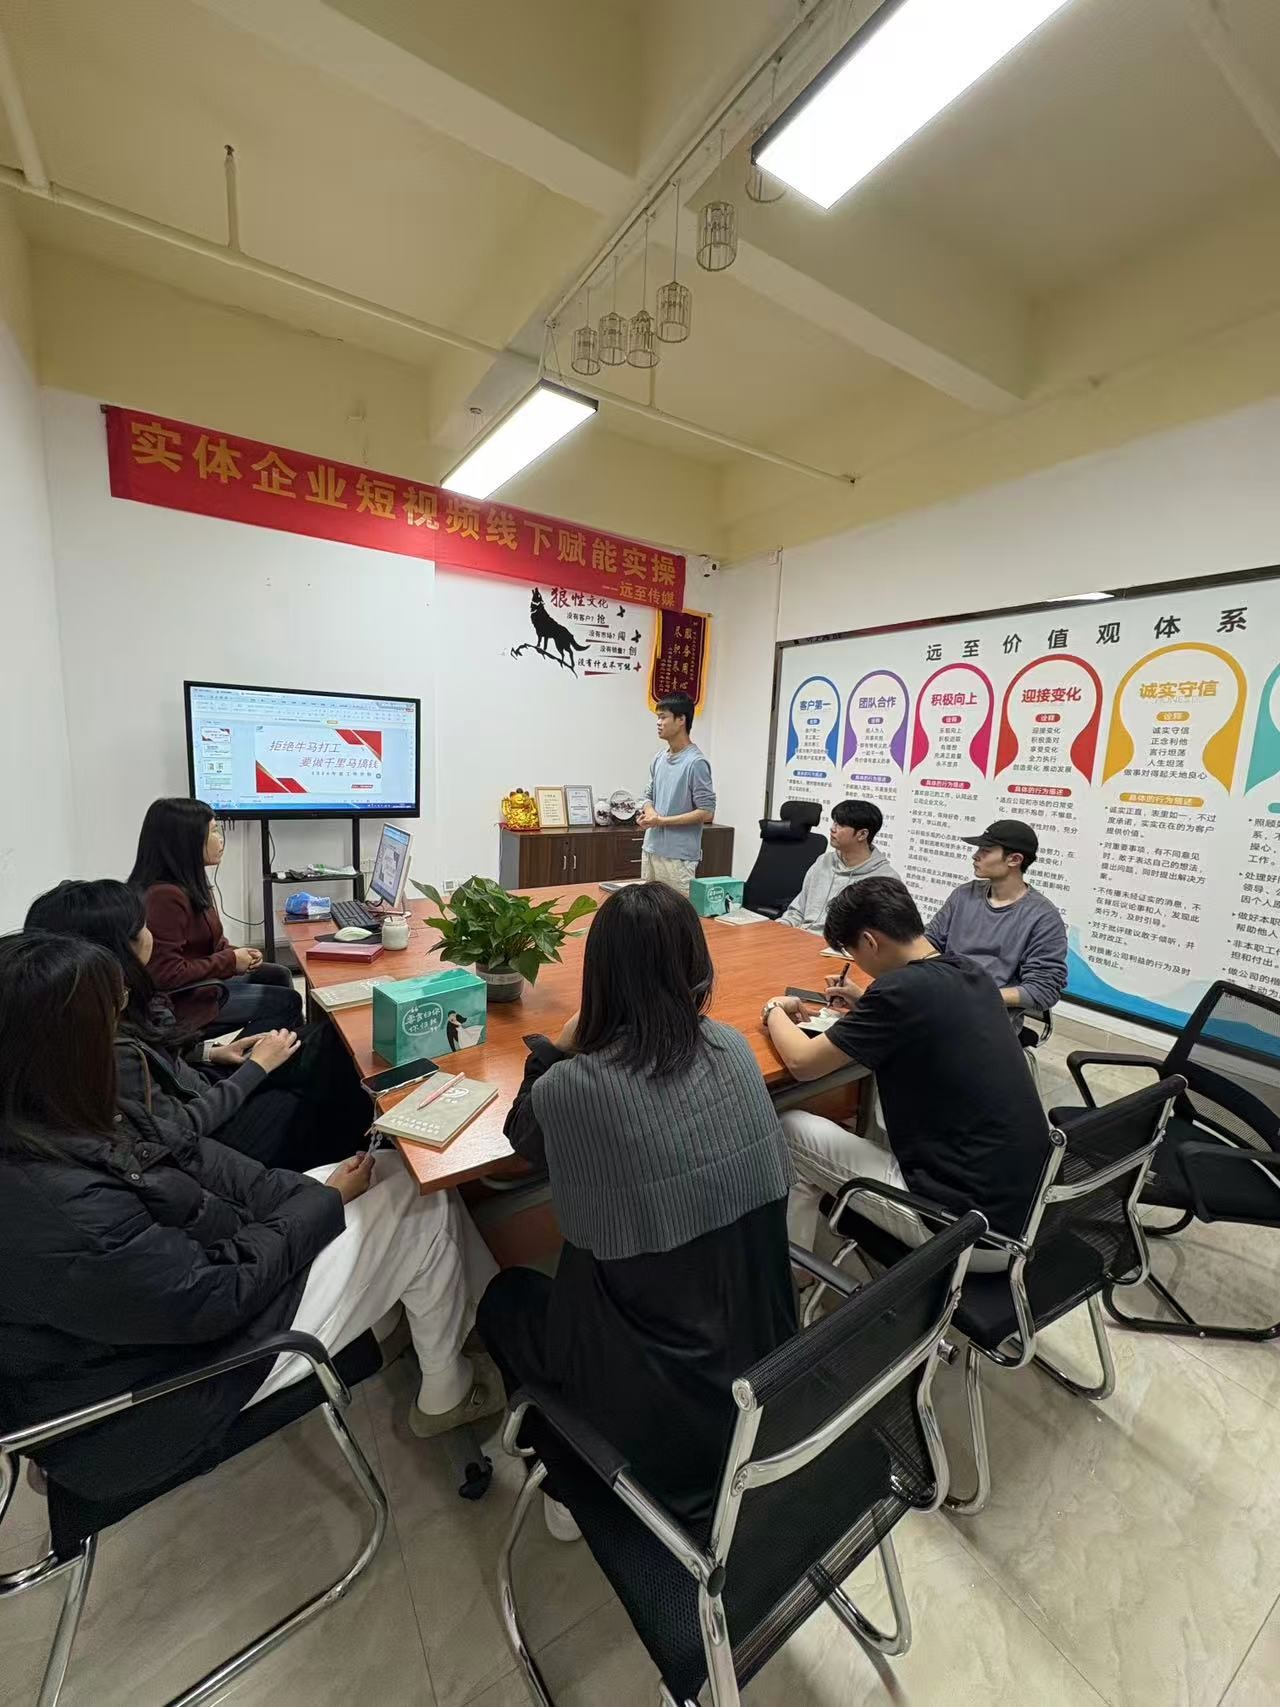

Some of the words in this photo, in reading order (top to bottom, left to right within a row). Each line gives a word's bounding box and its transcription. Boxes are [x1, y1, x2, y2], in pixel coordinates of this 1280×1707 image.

[131, 422, 676, 586] 实体企业短视频线下赋能实操
[551, 587, 608, 608] 狼性文化
[597, 614, 605, 624] 抢
[618, 631, 626, 641] 闯
[926, 607, 1248, 661] 远至价值观体系
[629, 646, 637, 656] 创
[578, 658, 631, 670] 没有什么不可能
[1021, 687, 1082, 703] 迎接变化
[1139, 680, 1219, 699] 诚实守信
[800, 700, 831, 710] 客户第一
[859, 696, 896, 709] 团队合作
[931, 692, 978, 706] 积极向上
[1152, 726, 1190, 735] 诚实守信
[269, 741, 341, 753] 拒绝牛马打工
[1150, 737, 1188, 746] 正念利他
[1149, 748, 1186, 756] 言行坦荡
[299, 757, 379, 769] 要做千里马搞钱
[1147, 759, 1184, 767] 人生坦荡
[1124, 769, 1208, 780] 做事对得起天地良心
[1014, 786, 1064, 796] 具体的行为描述
[1129, 794, 1193, 806] 具体的行为描述
[1110, 807, 1216, 822] 诚实正直，表里如一，不过
[1107, 817, 1215, 833] 度承诺，实实在在的为客户
[1106, 827, 1145, 838] 提供价值。
[1103, 842, 1200, 861] 对重要事项，有不同意见
[1102, 852, 1203, 873] 时，敢于表达自己的想法，
[1248, 855, 1275, 866] 工作。
[1101, 862, 1206, 885] 提出问题，同时提出解决方
[1244, 871, 1280, 884] 处理好
[1098, 887, 1201, 912] 不传播未经证实的消息，不
[1096, 897, 1200, 923] 在背后议论事和人，发现此
[1091, 931, 1127, 946] 及时改正。
[1093, 921, 1195, 950] 对于批评建议敢于倾听，并
[1088, 955, 1123, 970] 有效制止。
[1089, 945, 1191, 976] 对损害公司利益的行为及时
[1231, 951, 1279, 968] 担和付出。
